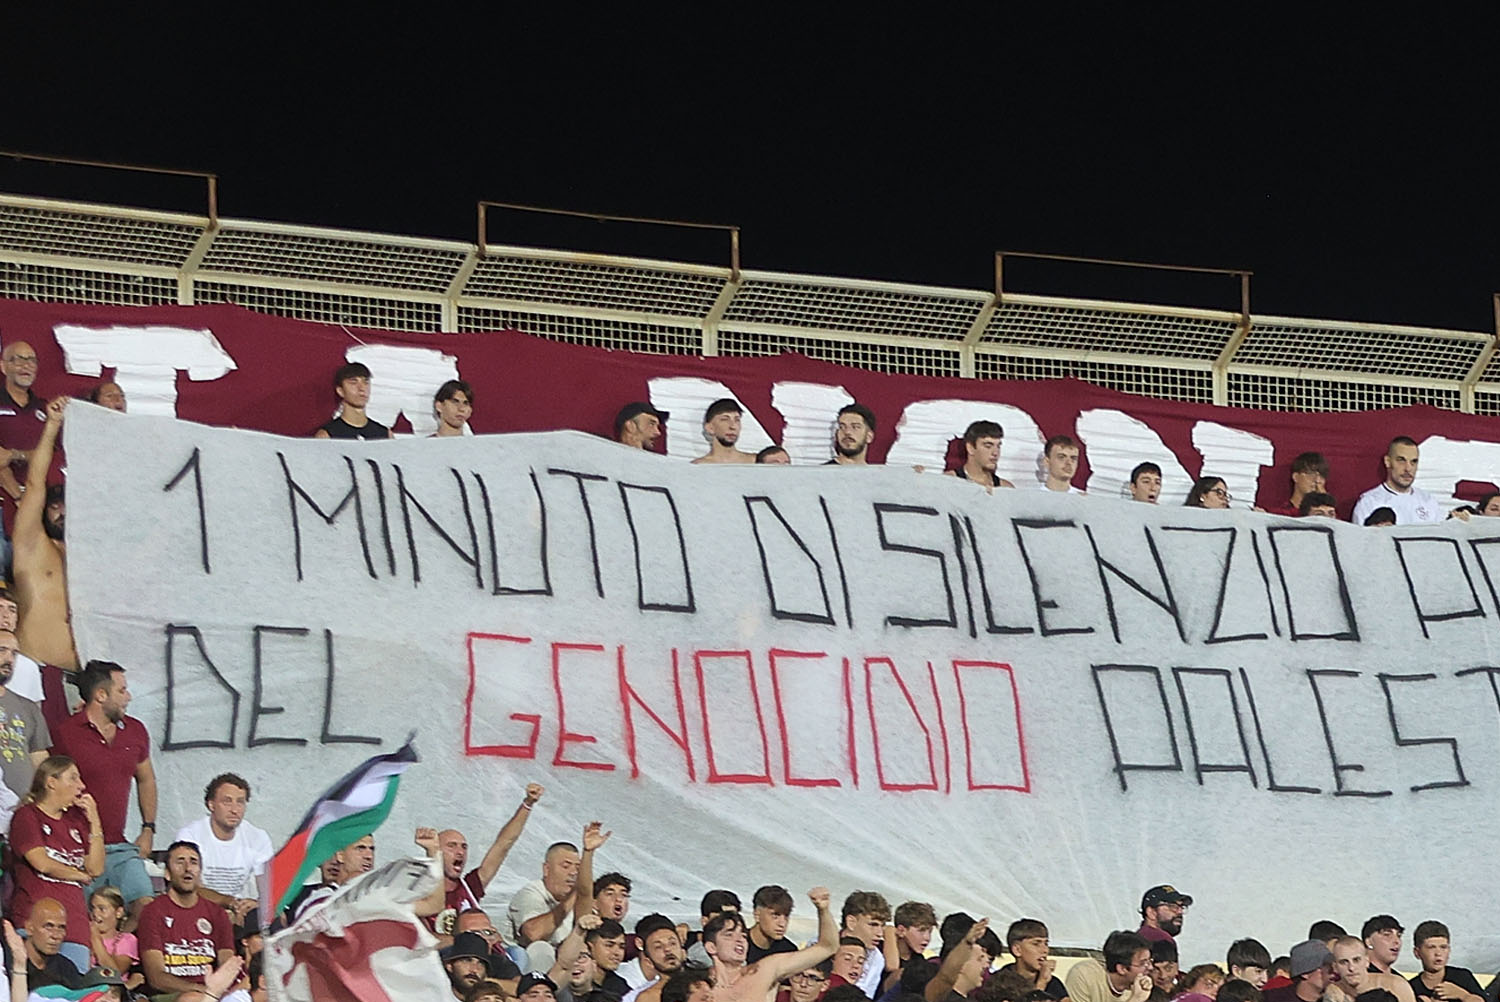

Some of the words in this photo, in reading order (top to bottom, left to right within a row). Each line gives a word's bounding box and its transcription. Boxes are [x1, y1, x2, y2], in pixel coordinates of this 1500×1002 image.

[163, 446, 210, 574] 1
[277, 450, 697, 614] MINUTO
[743, 493, 854, 629] DI
[873, 500, 1362, 644] SILENZIO
[161, 622, 382, 751] DEL
[464, 631, 1031, 795] GENOCIDIO
